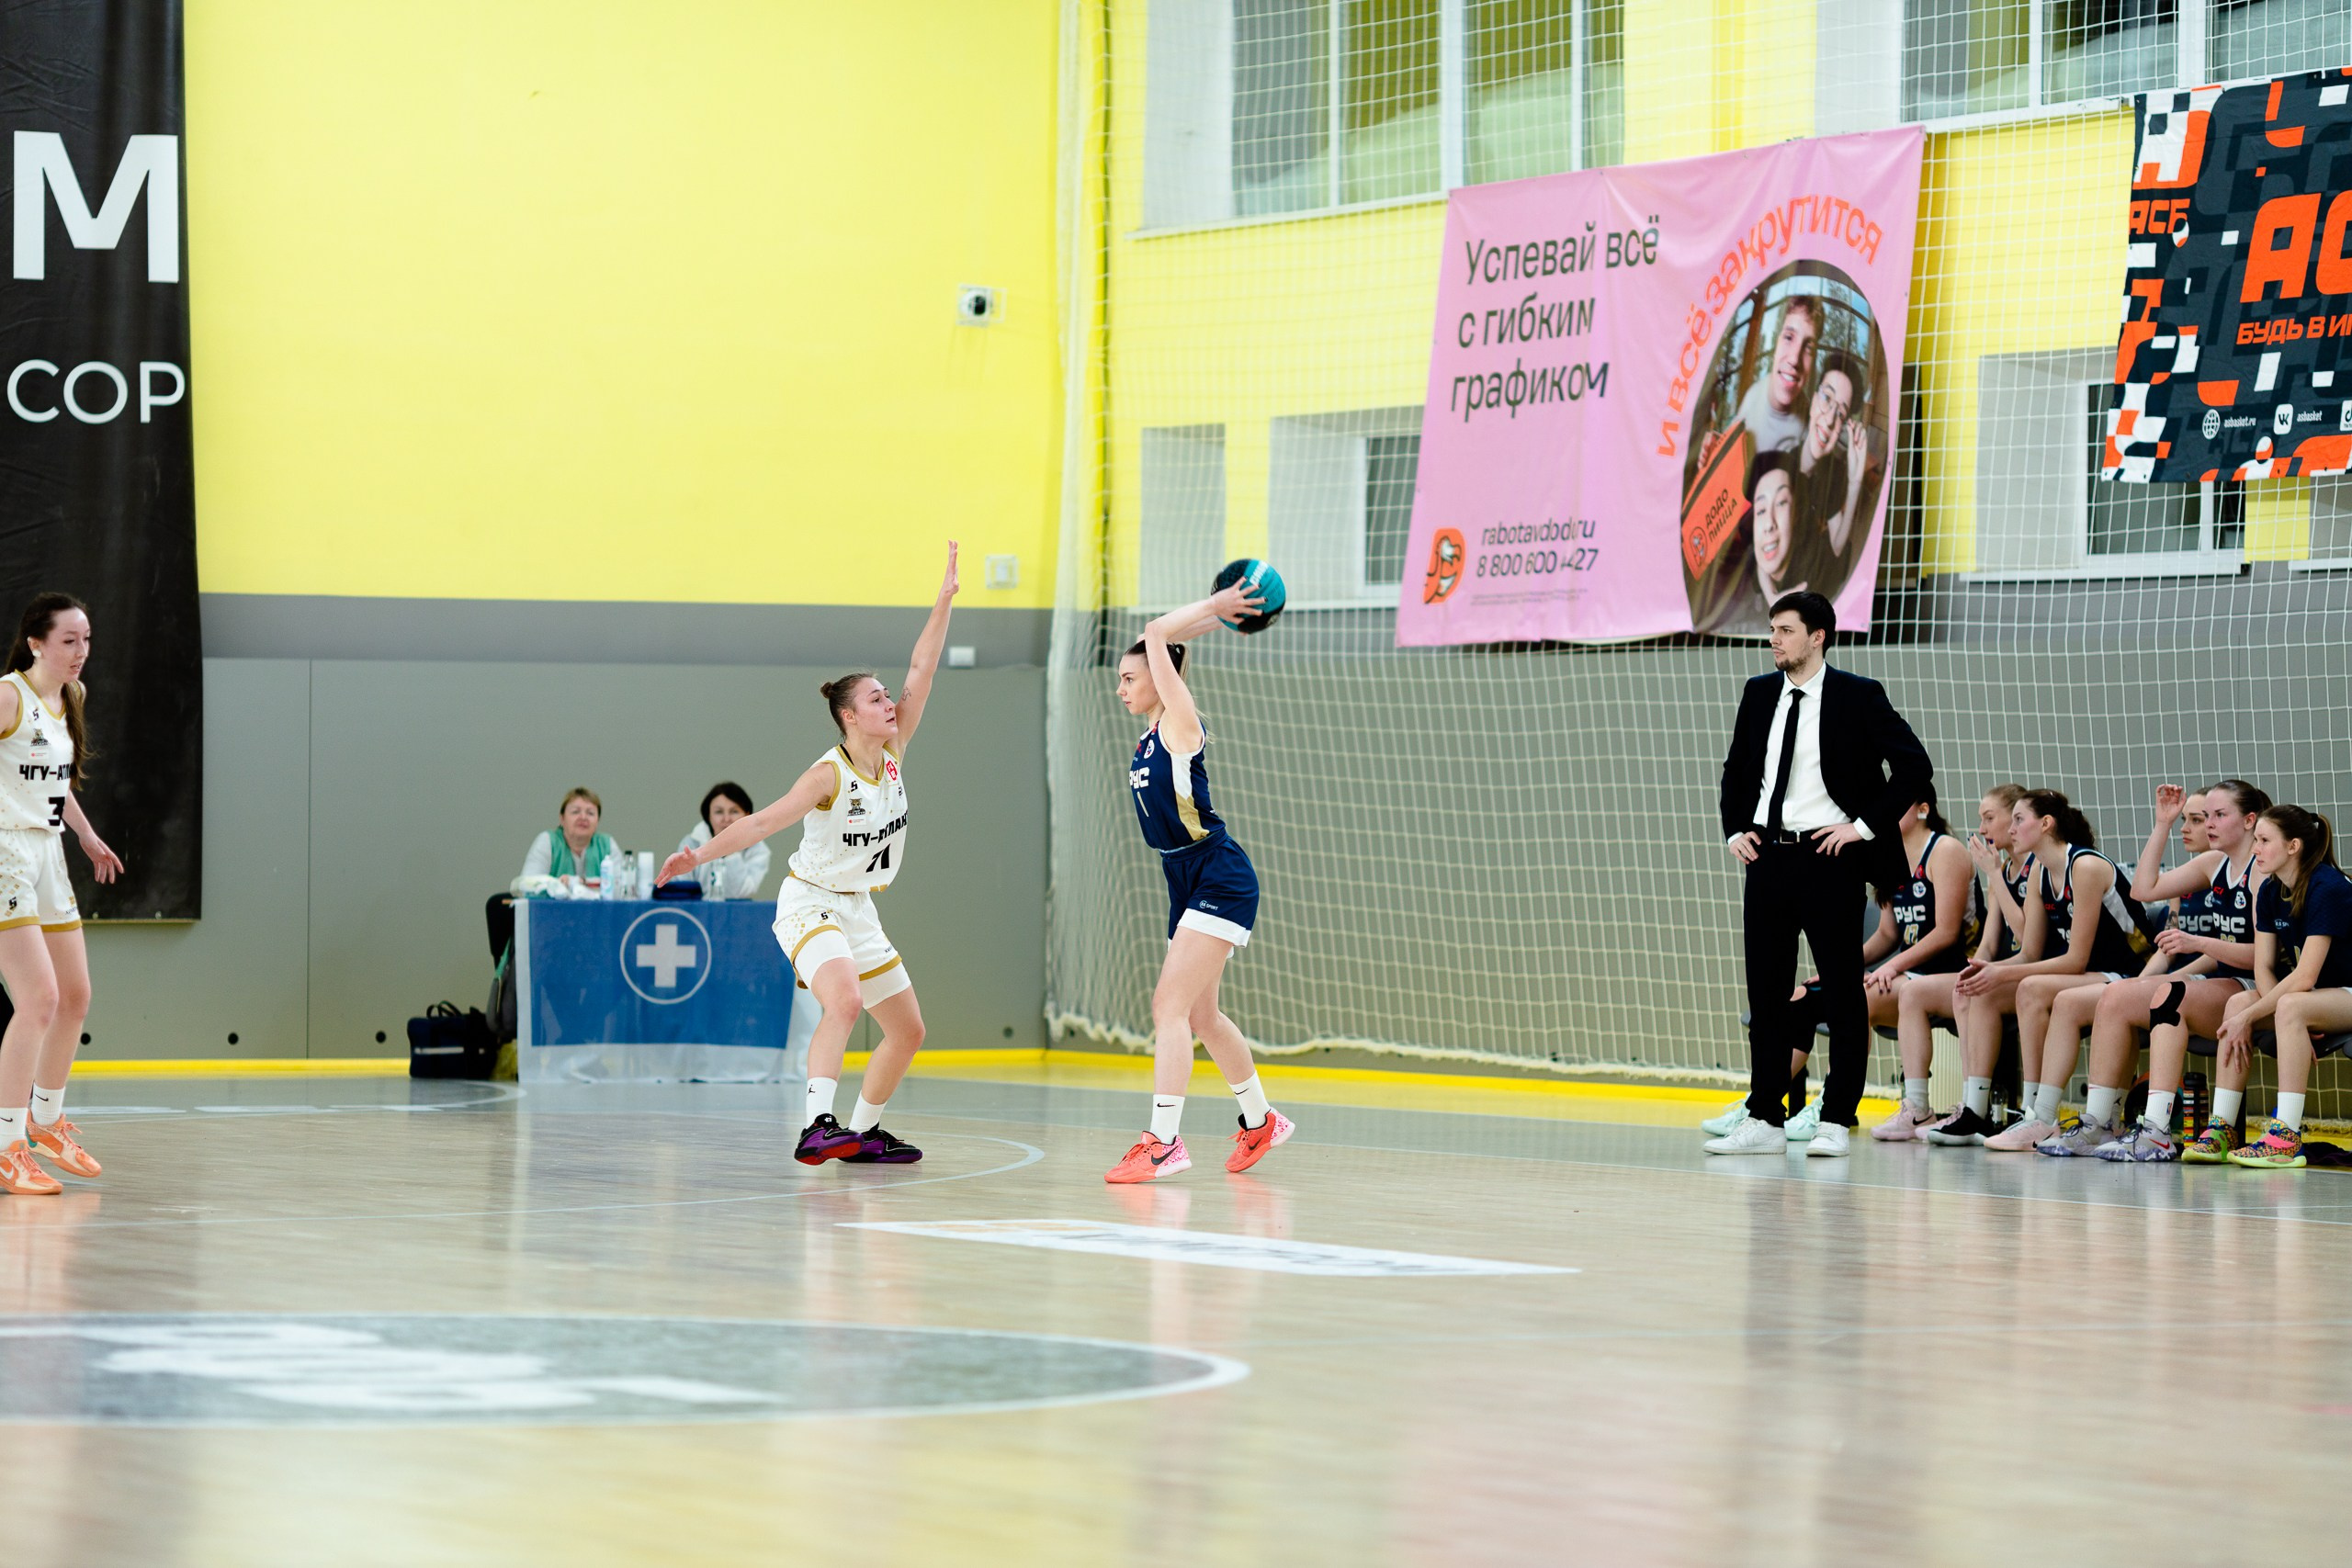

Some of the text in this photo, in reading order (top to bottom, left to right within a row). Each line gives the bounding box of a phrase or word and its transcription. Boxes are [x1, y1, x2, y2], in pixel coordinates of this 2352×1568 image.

[2129, 198, 2190, 235] АСБ
[1466, 214, 1659, 285] Успевай всё
[1458, 291, 1596, 348] с гибким
[1657, 194, 1883, 457] и всё закрутится
[2236, 318, 2303, 345] БУДЬ
[2306, 315, 2326, 339] В
[1451, 356, 1610, 423] графиком
[1705, 489, 1729, 529] ДОДО
[1709, 498, 1738, 543] ПИЦЦА
[1476, 555, 1488, 578] 8
[1489, 552, 1523, 577] 800
[1525, 549, 1558, 575] 600
[48, 796, 65, 827] 3
[1894, 905, 1927, 923] РУС
[2212, 912, 2246, 934] РУС
